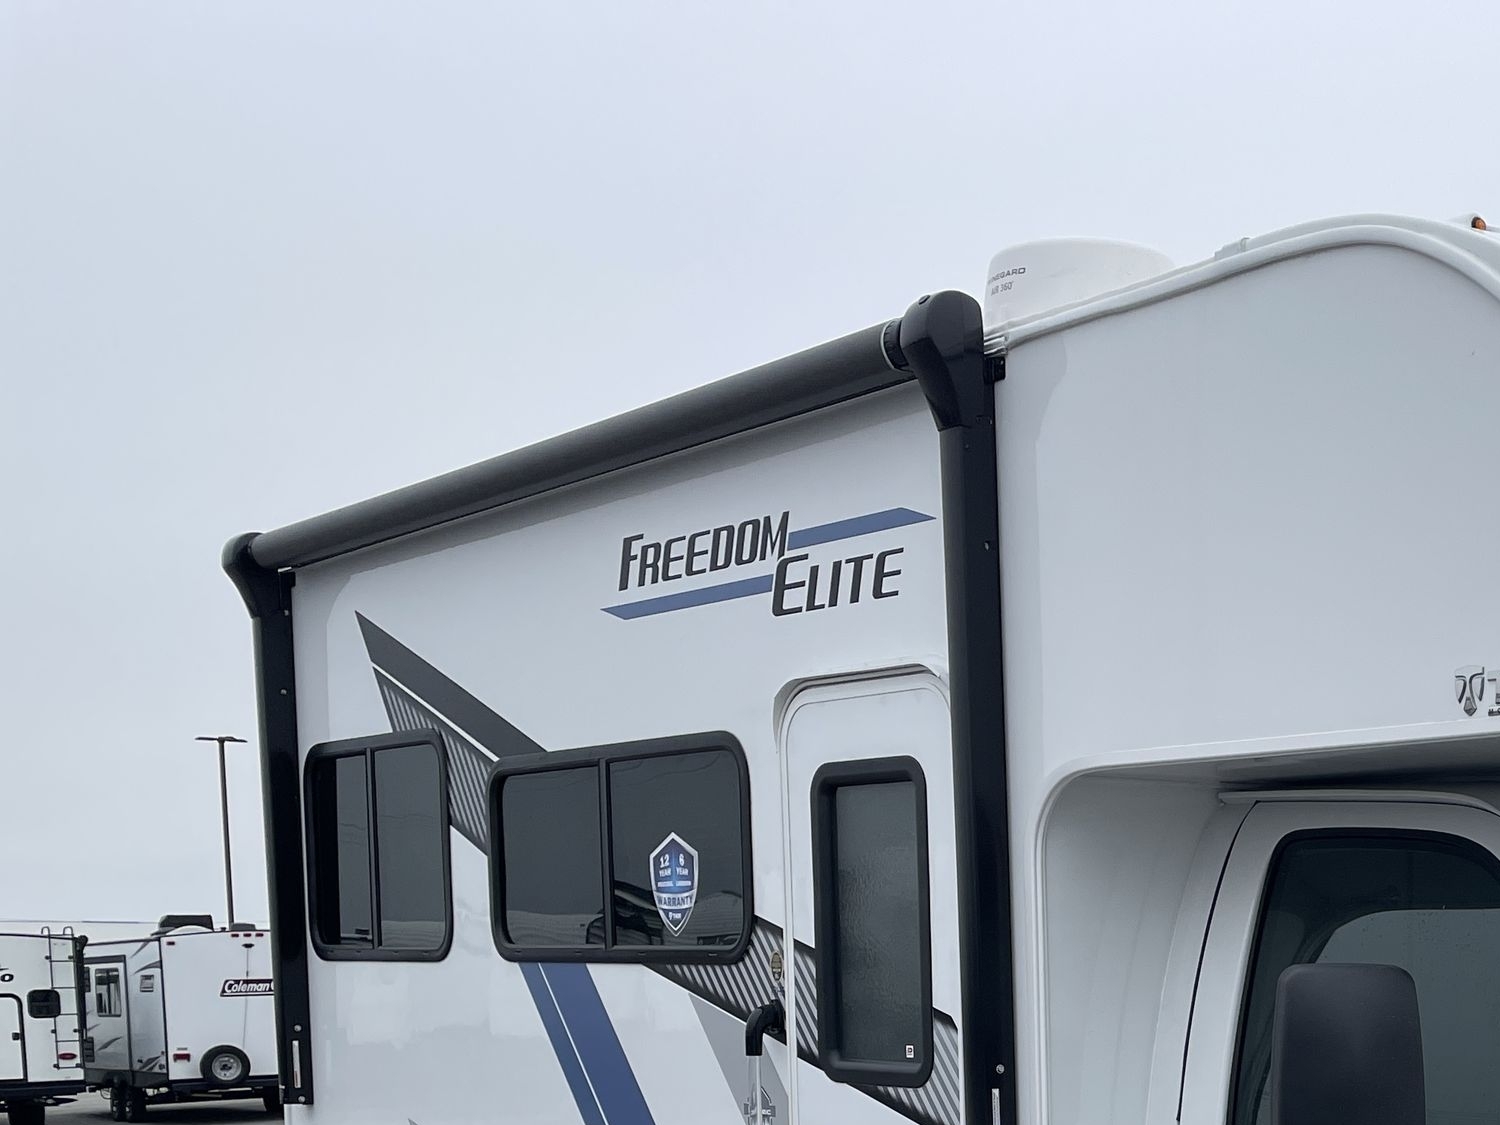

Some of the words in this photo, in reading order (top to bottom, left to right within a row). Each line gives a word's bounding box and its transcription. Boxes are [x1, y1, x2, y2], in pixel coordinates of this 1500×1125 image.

[618, 510, 790, 591] FREEDOM
[771, 547, 904, 617] ELITE
[660, 854, 669, 868] 12
[679, 853, 685, 866] 6
[659, 867, 671, 877] YEAR
[676, 866, 689, 876] YEAR
[656, 895, 693, 907] WARRANTY
[224, 980, 270, 993] Coleman
